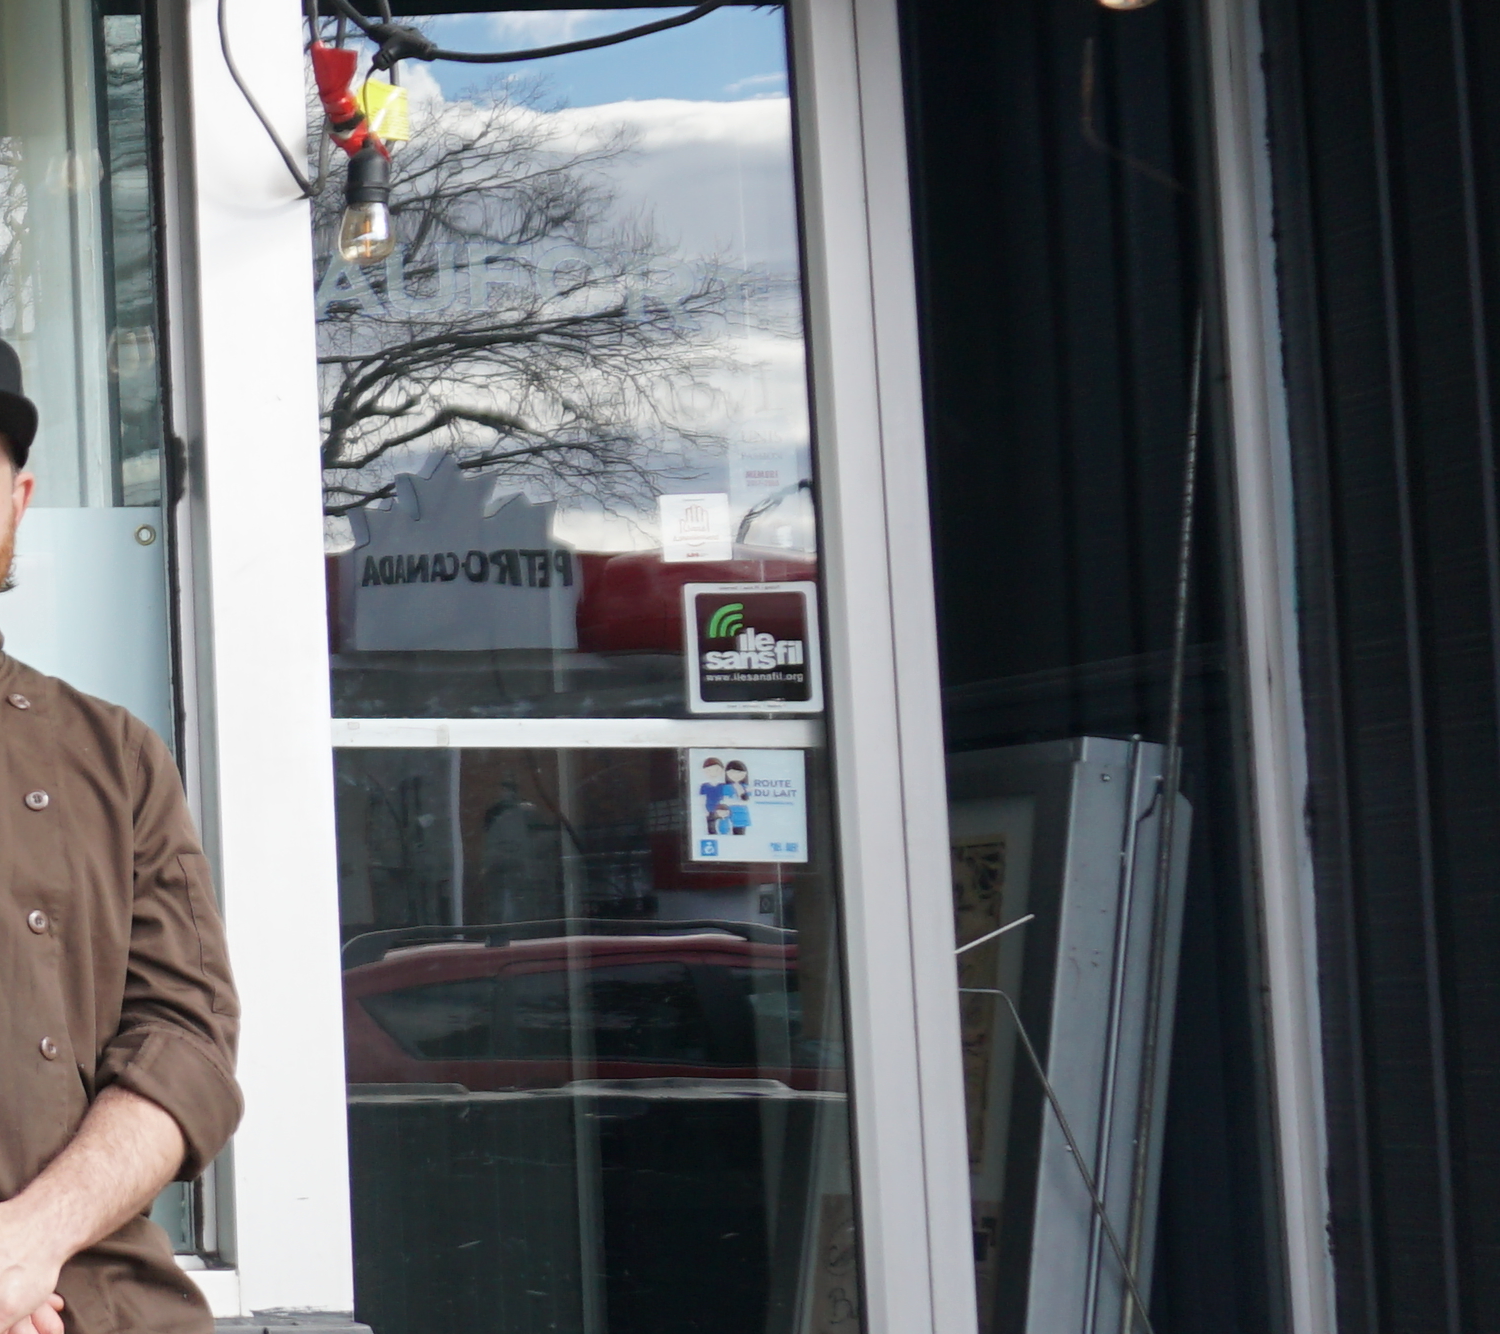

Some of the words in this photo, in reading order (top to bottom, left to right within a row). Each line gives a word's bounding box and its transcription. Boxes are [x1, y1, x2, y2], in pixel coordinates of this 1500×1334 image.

[705, 651, 777, 670] sans
[774, 640, 804, 665] fil
[754, 779, 792, 788] ROUTE
[754, 789, 770, 798] DU
[773, 789, 797, 798] LAIT
